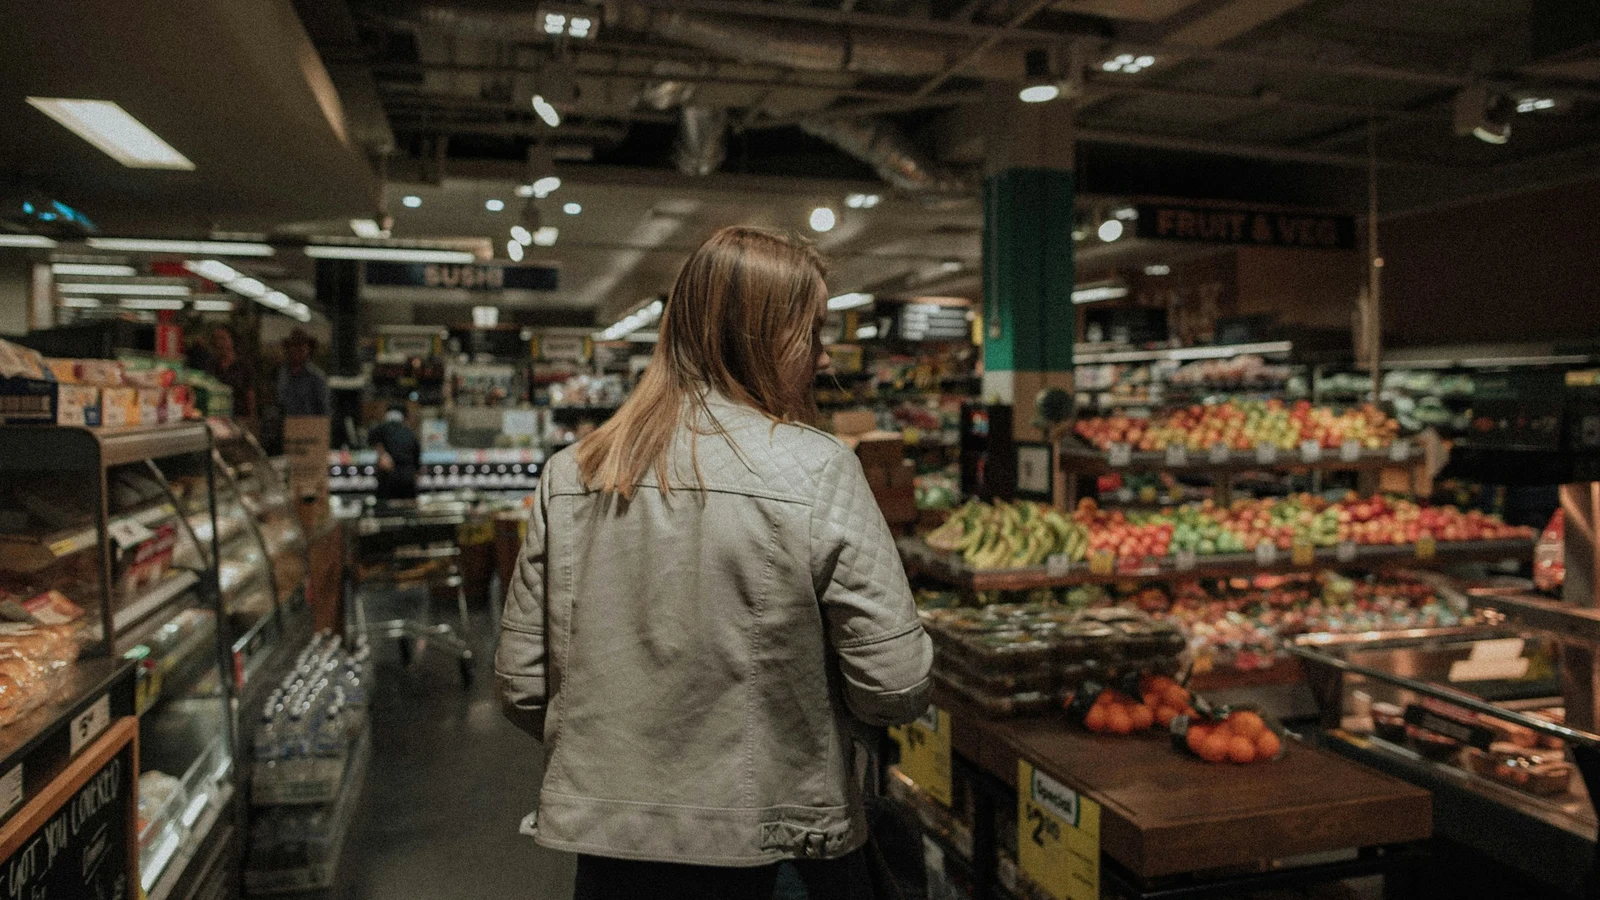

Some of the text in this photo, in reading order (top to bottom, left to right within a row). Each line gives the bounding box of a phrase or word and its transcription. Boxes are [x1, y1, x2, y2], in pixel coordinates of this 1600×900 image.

[1156, 209, 1335, 244] FRUIT & VEG
[424, 264, 503, 287] SUSHI
[1036, 778, 1073, 816] Special
